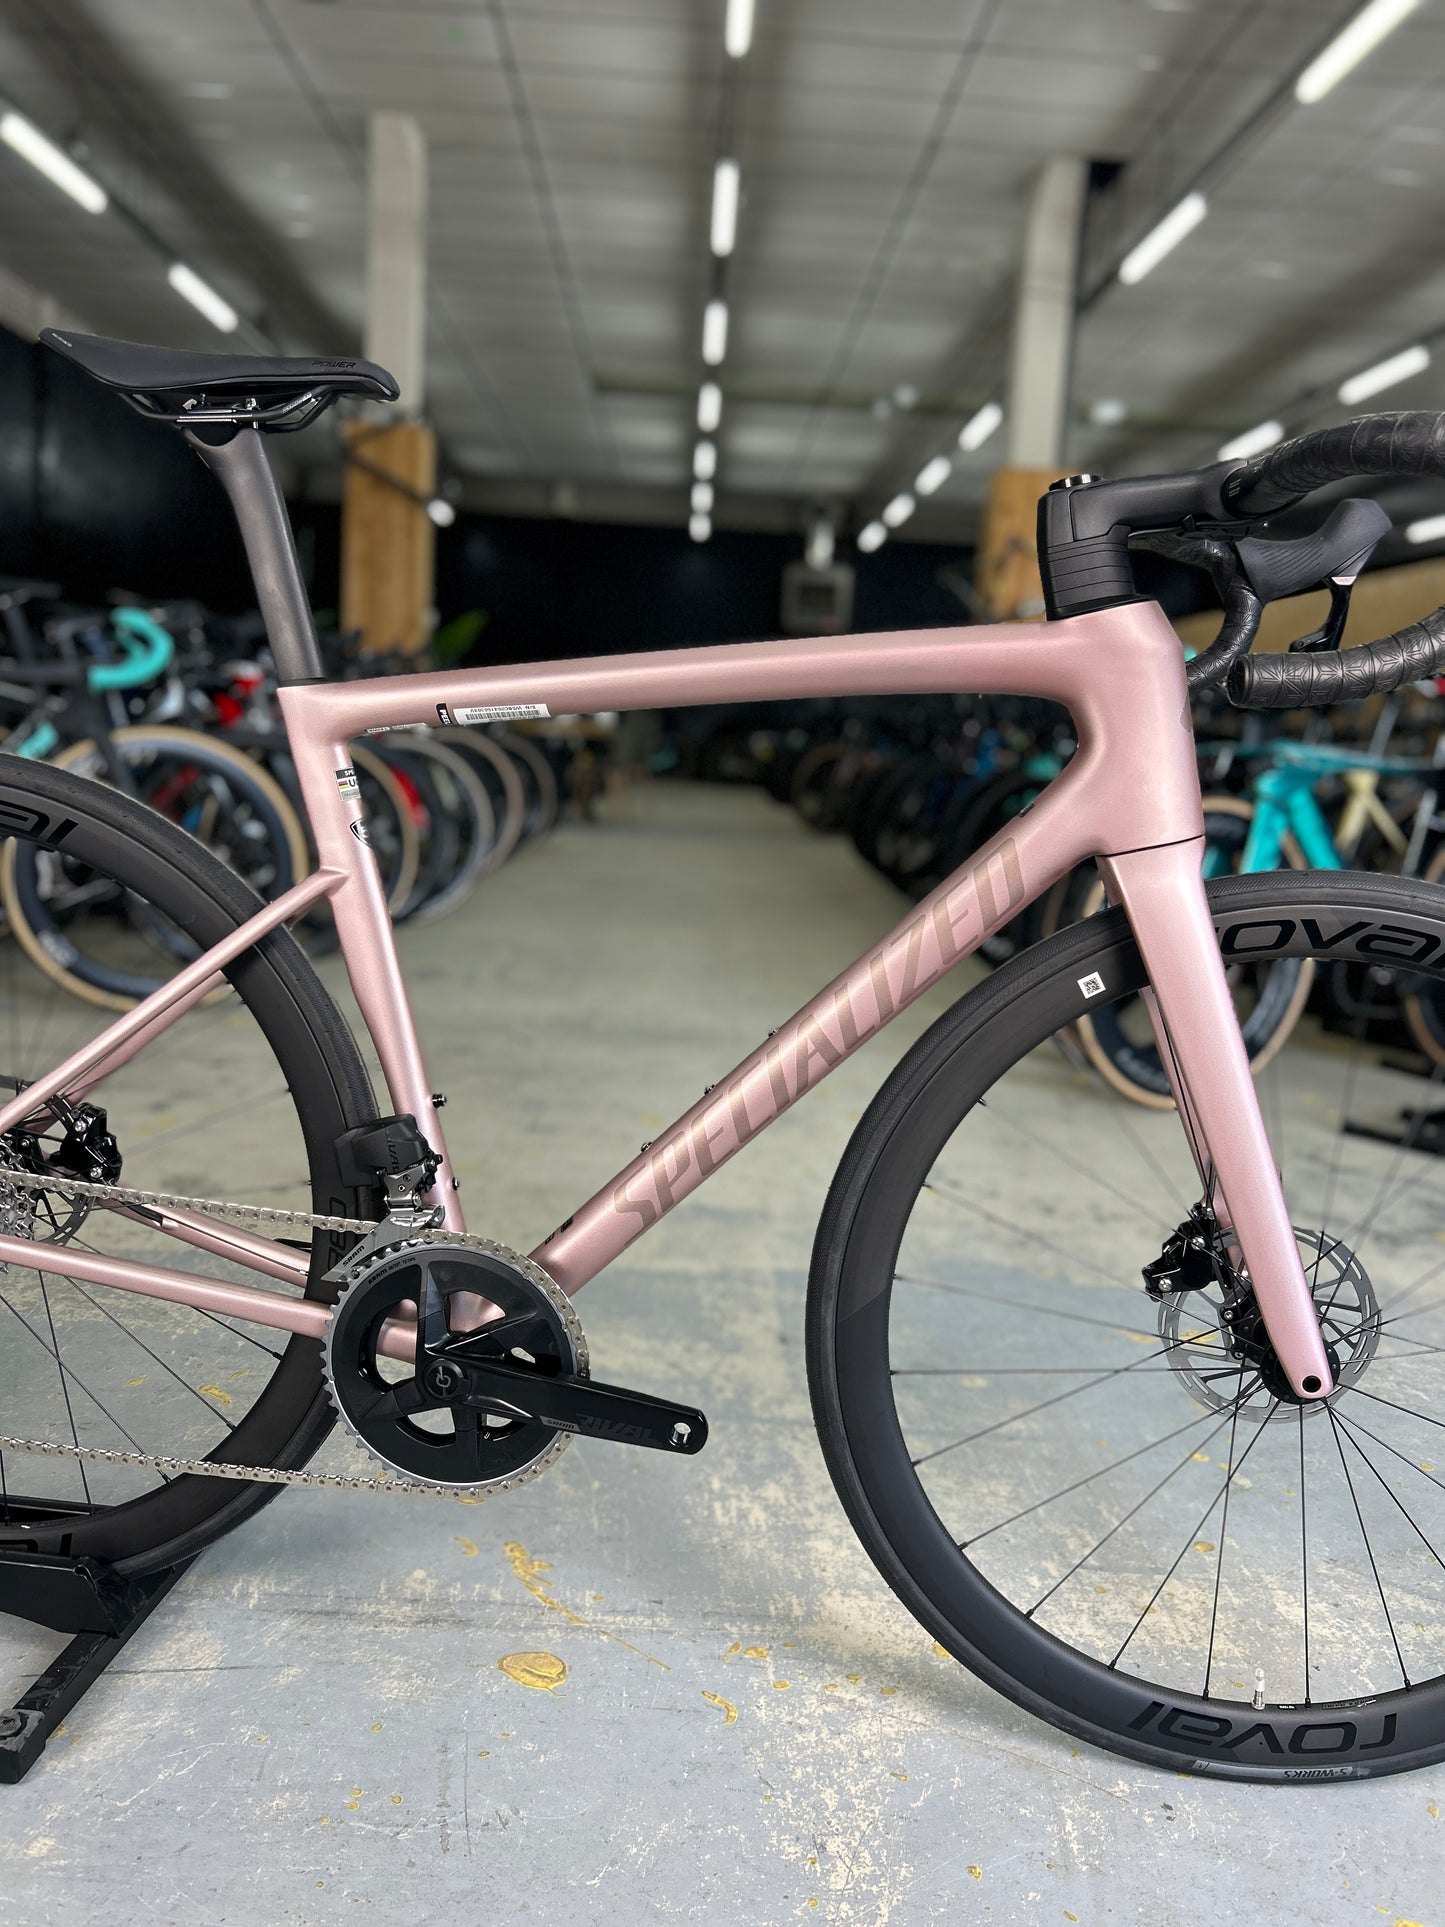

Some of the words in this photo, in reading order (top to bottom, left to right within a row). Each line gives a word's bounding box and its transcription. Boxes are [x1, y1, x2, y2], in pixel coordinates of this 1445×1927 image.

[312, 360, 357, 369] POWER
[1215, 918, 1445, 970] ova
[613, 837, 1026, 1247] SPECIALIZED
[342, 1245, 365, 1267] SRAM
[546, 1419, 574, 1430] SRAM
[575, 1413, 657, 1441] RIVAL
[1126, 1700, 1398, 1754] roval
[1284, 1767, 1349, 1779] S-WORKS
